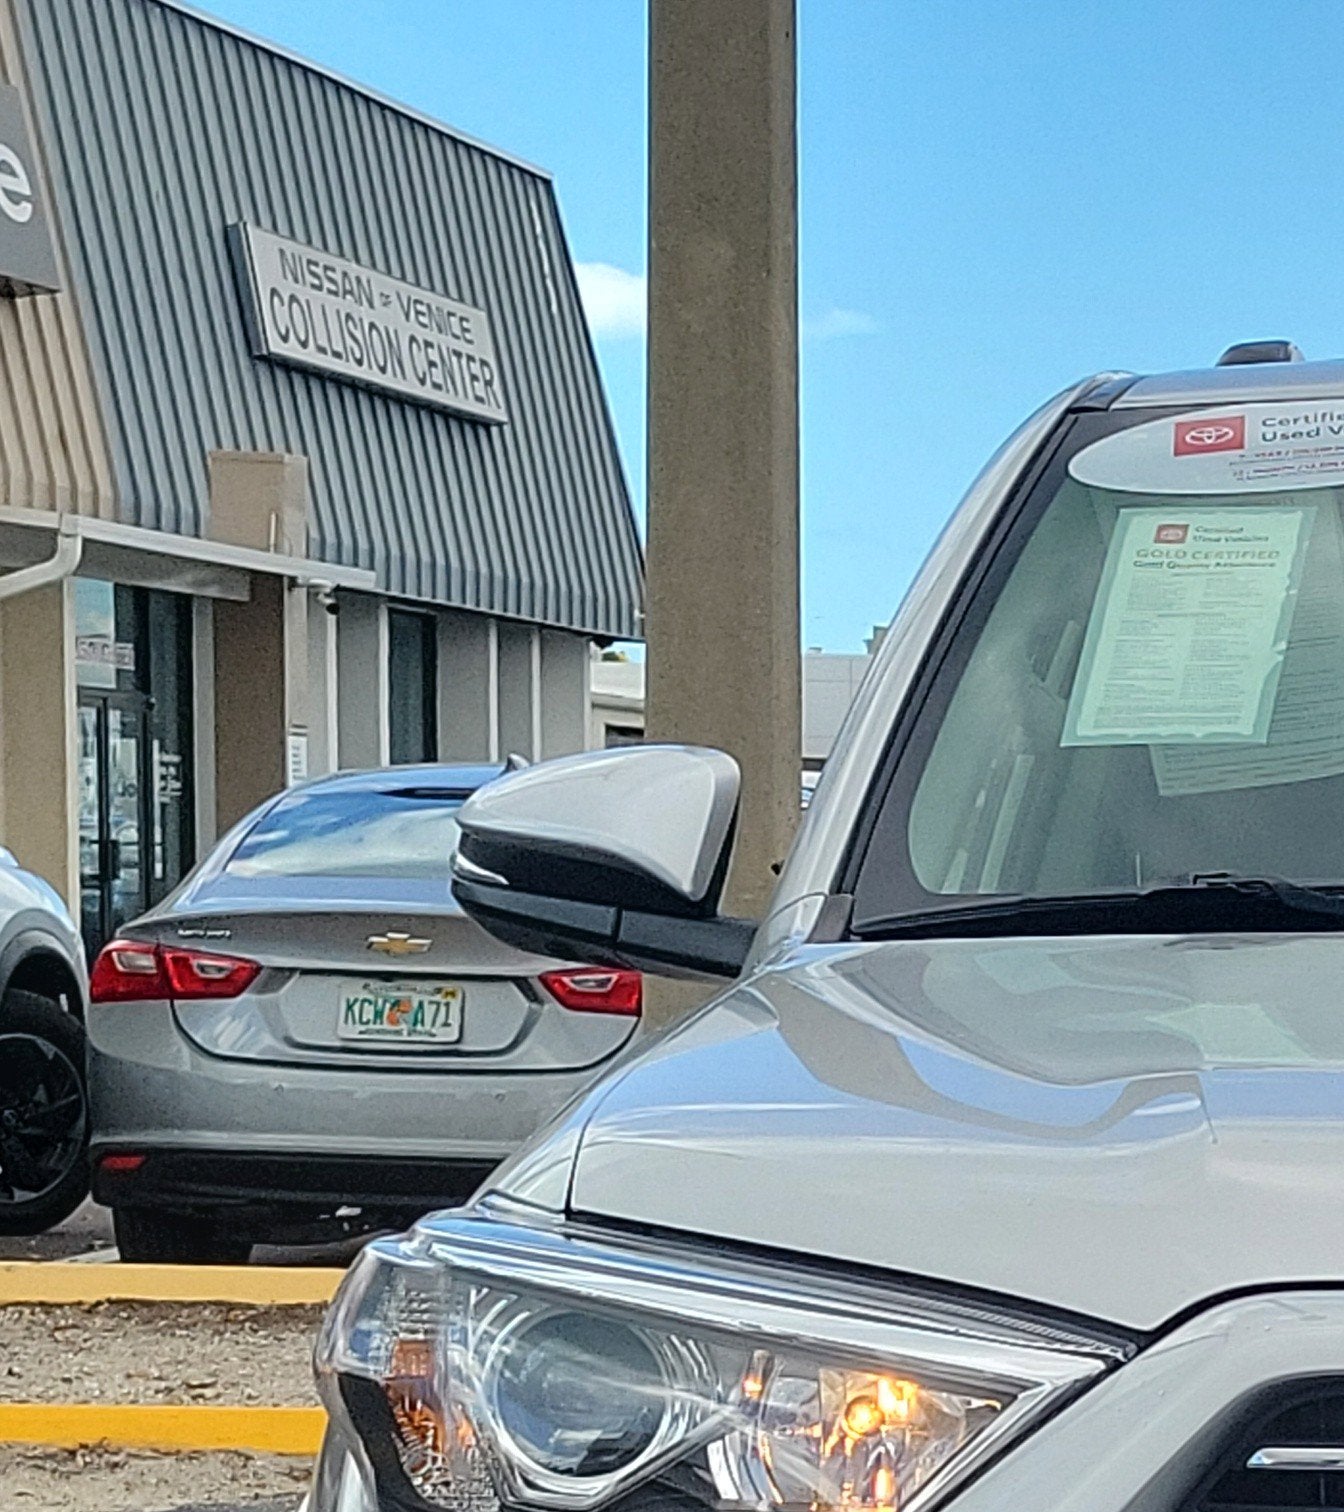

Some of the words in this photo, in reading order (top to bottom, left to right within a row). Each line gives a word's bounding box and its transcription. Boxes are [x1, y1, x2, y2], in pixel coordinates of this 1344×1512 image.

[279, 248, 375, 310] NISSAN
[396, 290, 475, 345] VENICE
[269, 287, 407, 380] COLLISION
[408, 334, 501, 409] CENTER
[1261, 426, 1320, 442] Used
